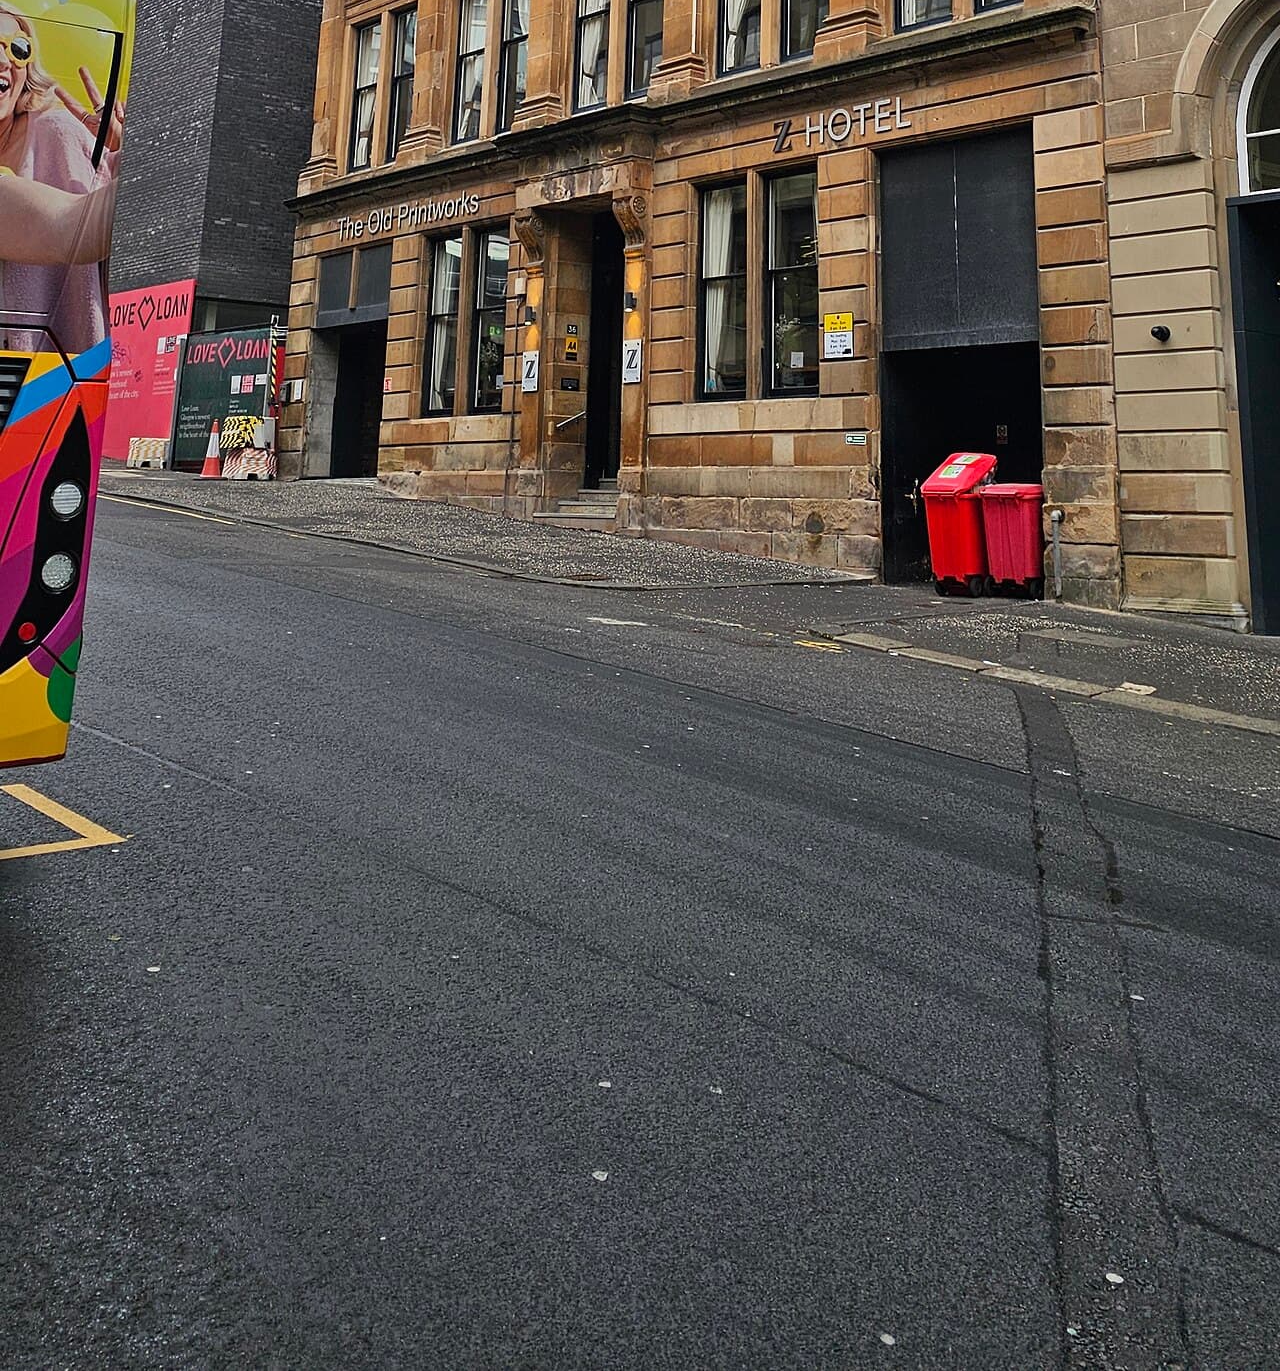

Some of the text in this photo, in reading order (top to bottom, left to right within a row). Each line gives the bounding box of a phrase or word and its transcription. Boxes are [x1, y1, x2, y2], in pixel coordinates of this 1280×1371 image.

[773, 96, 912, 154] Z HOTEL
[337, 190, 480, 242] The Old Printworks
[156, 293, 189, 321] LOAN
[567, 325, 577, 334] 36
[187, 343, 218, 365] LOVE
[236, 338, 271, 361] LOAN
[626, 349, 638, 369] Z
[525, 360, 536, 379] Z
